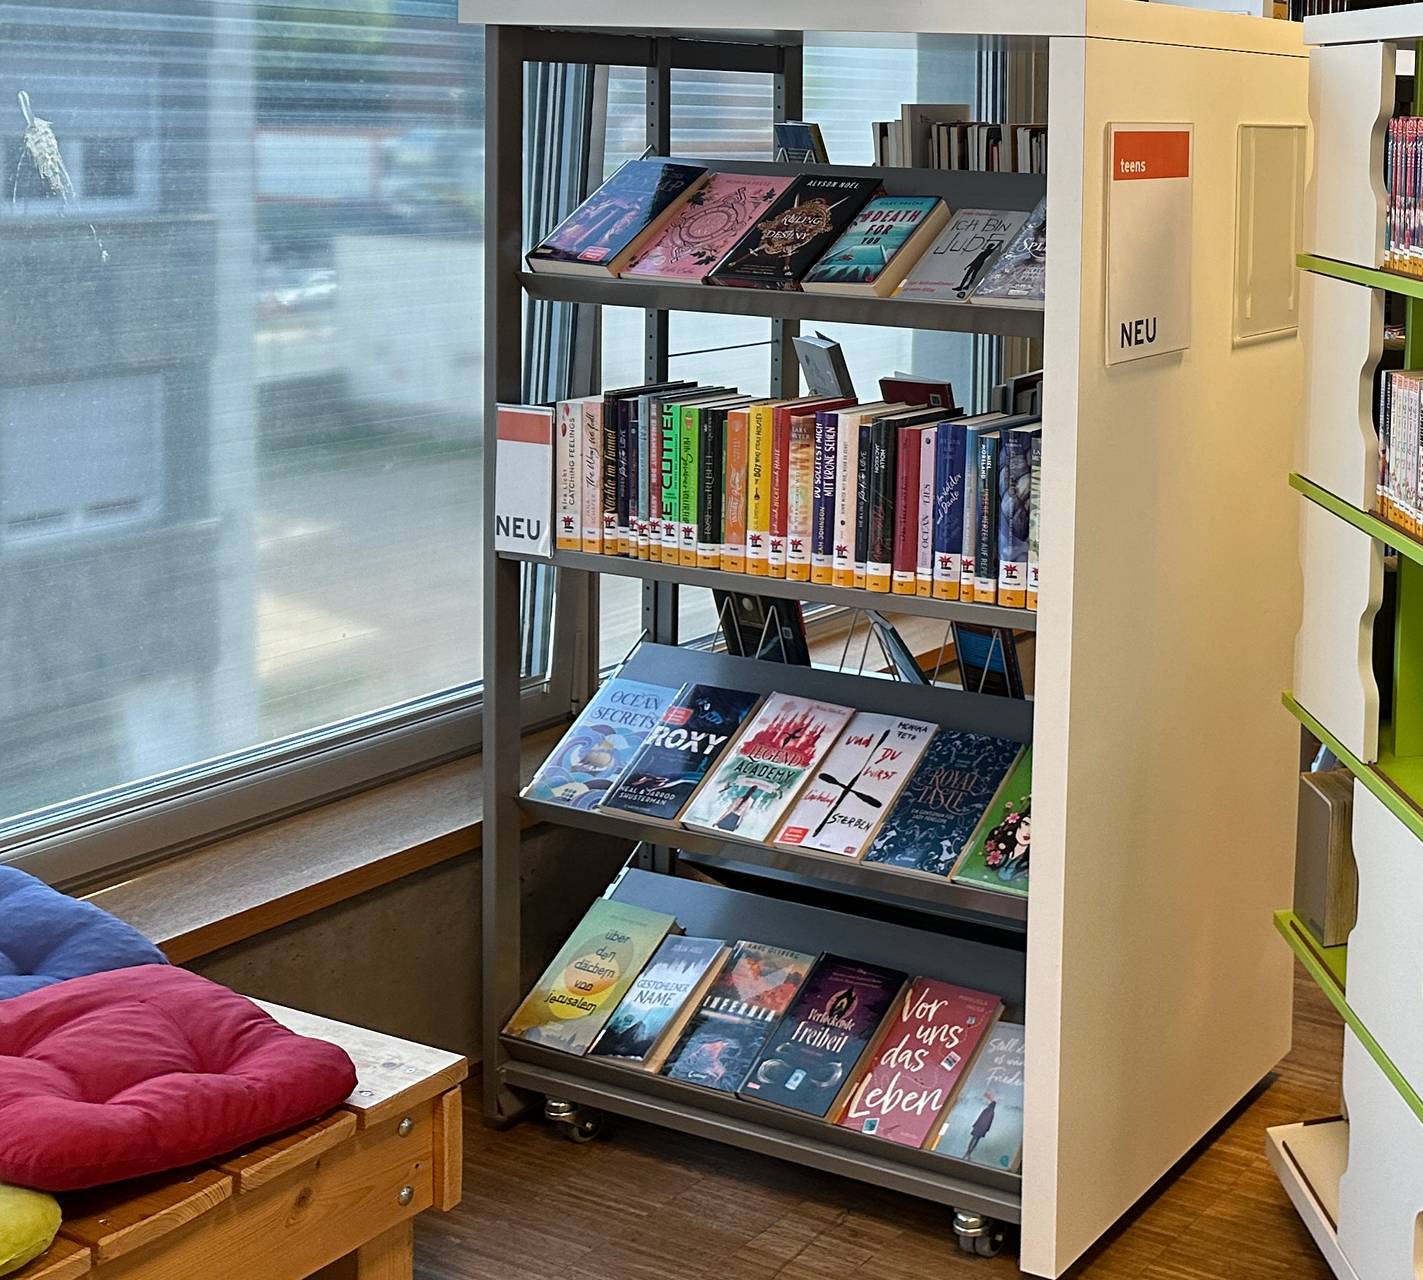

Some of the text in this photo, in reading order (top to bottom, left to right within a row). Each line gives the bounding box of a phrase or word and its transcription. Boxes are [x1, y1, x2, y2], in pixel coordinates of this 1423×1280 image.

[1120, 158, 1146, 173] teens
[807, 180, 838, 189] ALYSON
[764, 228, 809, 241] DESTINY
[865, 225, 893, 235] FOR
[951, 218, 1012, 233] ICH BIN
[1120, 317, 1157, 348] NEU
[814, 423, 823, 444] MICH
[568, 417, 576, 506] CATCHING FEELINGS
[607, 465, 616, 477] im
[753, 463, 761, 478] BOY
[814, 446, 823, 484] SOLLTEST
[824, 426, 836, 497] MIT KRONE SEHEN
[817, 506, 825, 540] JOHNSON
[920, 483, 931, 549] OCEAN LIES
[496, 514, 541, 541] NEU
[610, 690, 662, 711] OCEAN
[592, 707, 657, 730] SECRETS
[647, 725, 727, 755] ROXY
[734, 759, 796, 785] ACADEMY
[618, 792, 672, 806] SHUSTERMAN
[620, 785, 640, 795] NEAL
[826, 813, 873, 832] STERBEN
[604, 927, 630, 944] über
[574, 958, 616, 978] dächern
[573, 980, 594, 991] von
[633, 990, 678, 1007] NAME
[901, 987, 949, 1023] Vor
[791, 1021, 849, 1053] Freiheit
[915, 1023, 963, 1050] uns
[880, 1035, 929, 1073] das
[848, 1071, 943, 1119] Leben
